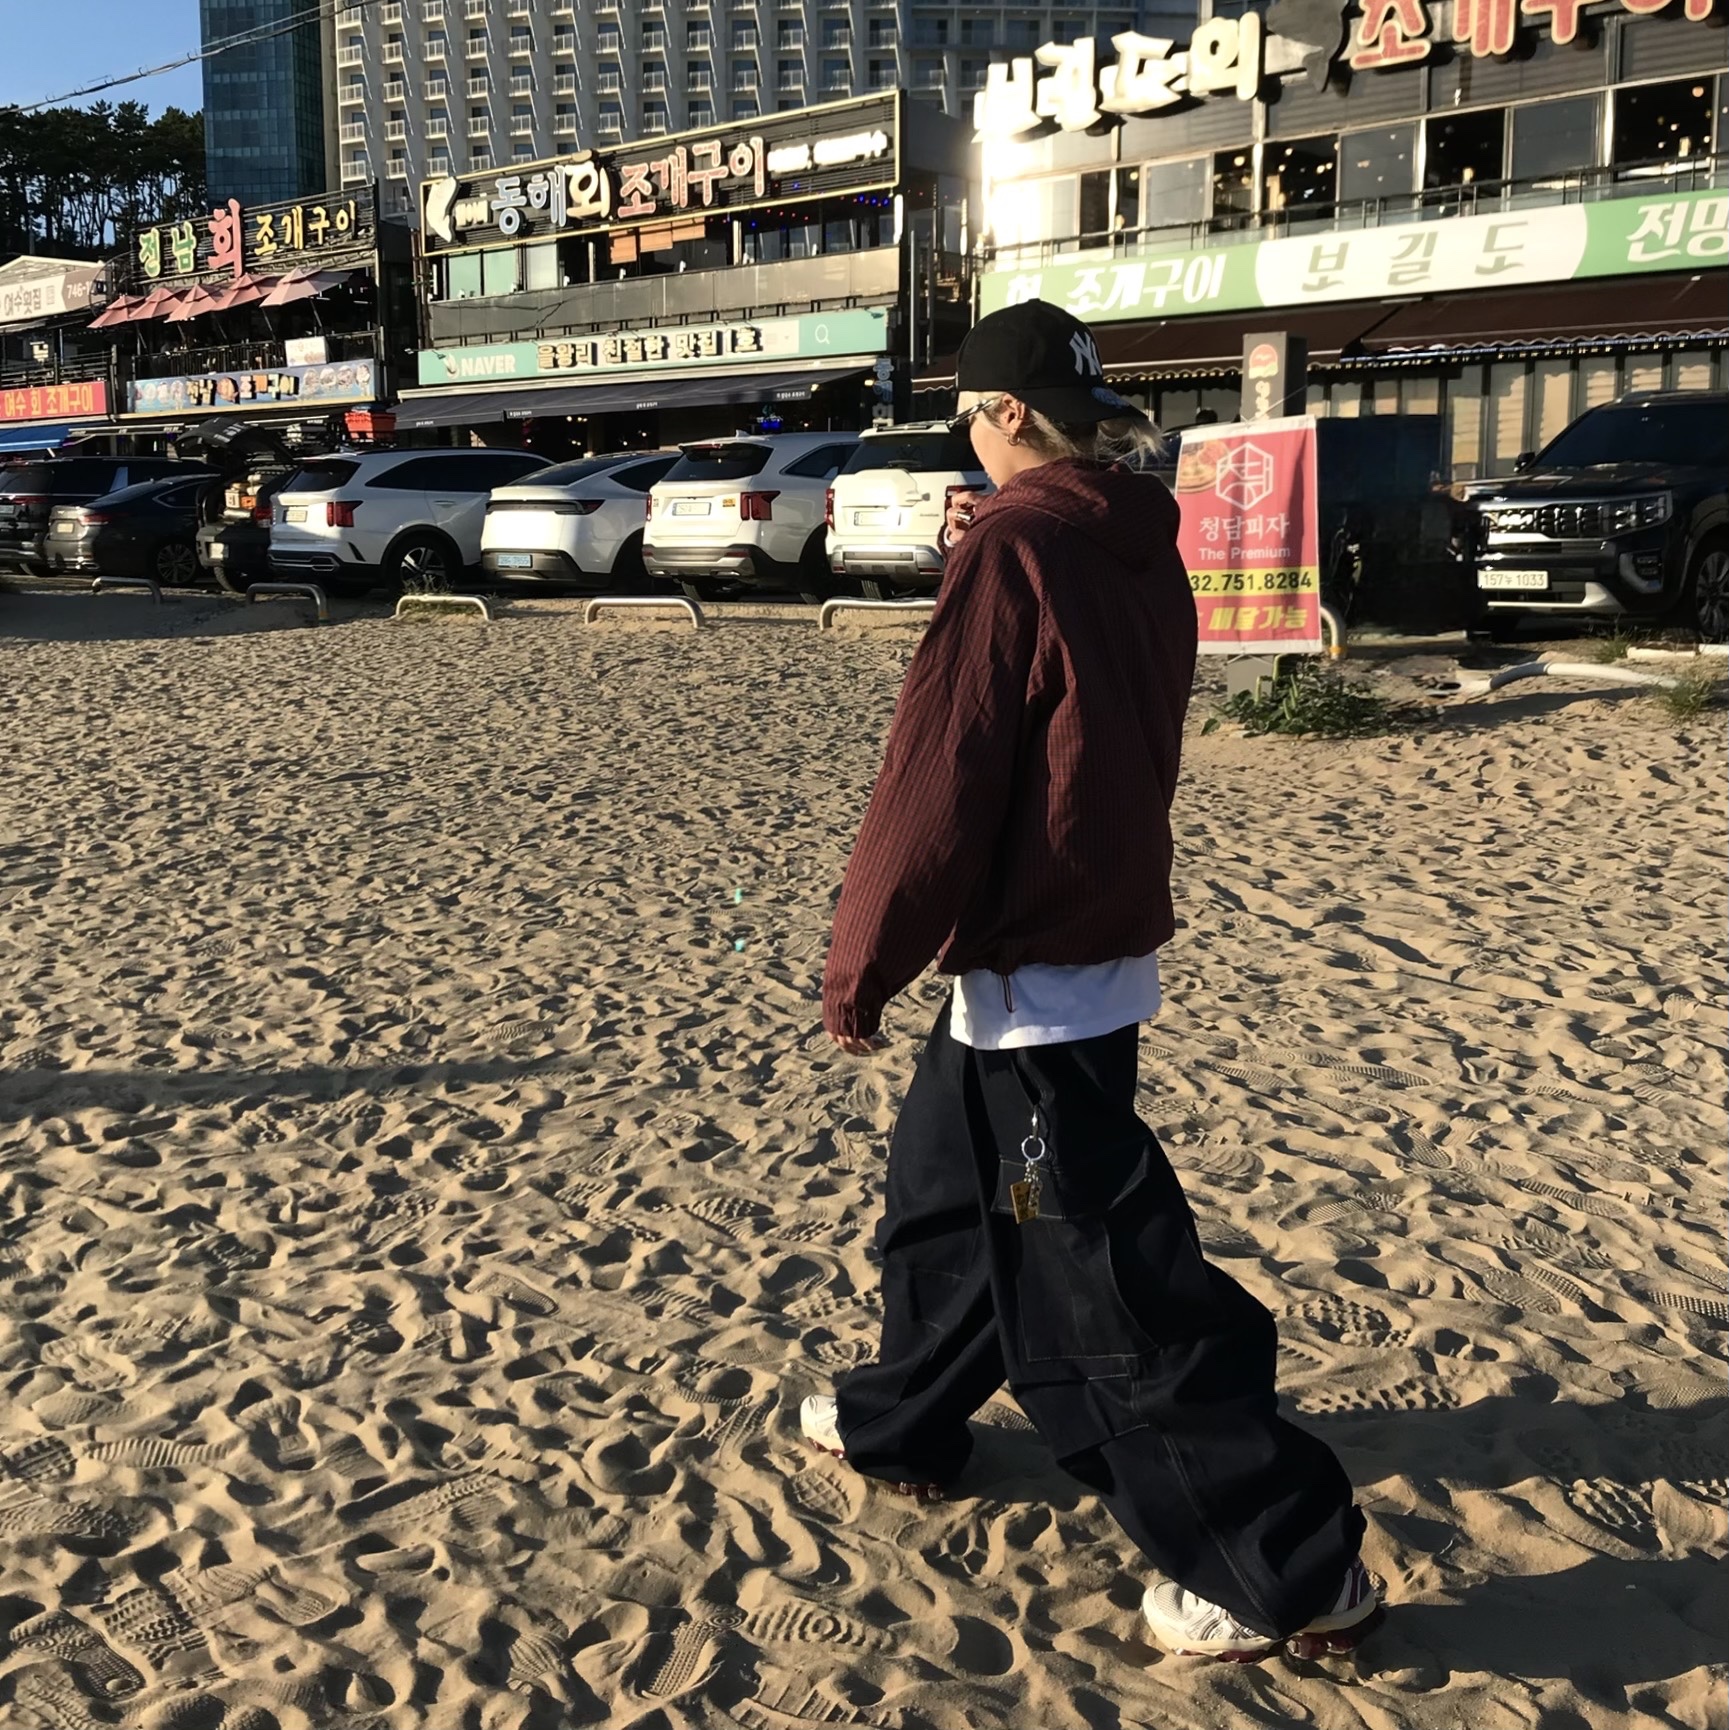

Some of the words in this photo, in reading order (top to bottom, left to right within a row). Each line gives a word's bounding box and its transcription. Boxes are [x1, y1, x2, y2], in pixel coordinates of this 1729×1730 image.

[1350, 0, 1713, 69] 조개
[617, 136, 765, 218] 조개구이
[254, 200, 355, 256] 조개구이
[1302, 221, 1529, 292] 보길도
[1066, 254, 1227, 316] 조개구이
[461, 355, 516, 376] NAVER
[537, 342, 592, 369] 을왕리
[603, 336, 665, 363] 친절한
[676, 330, 717, 358] 맛집
[4, 391, 27, 417] 여수
[46, 385, 94, 414] 조개구이
[1199, 513, 1290, 541] 청담피자
[1198, 548, 1225, 560] The
[1231, 546, 1291, 560] Premium
[1516, 573, 1545, 586] 1033
[1208, 605, 1308, 631] 배달가능
